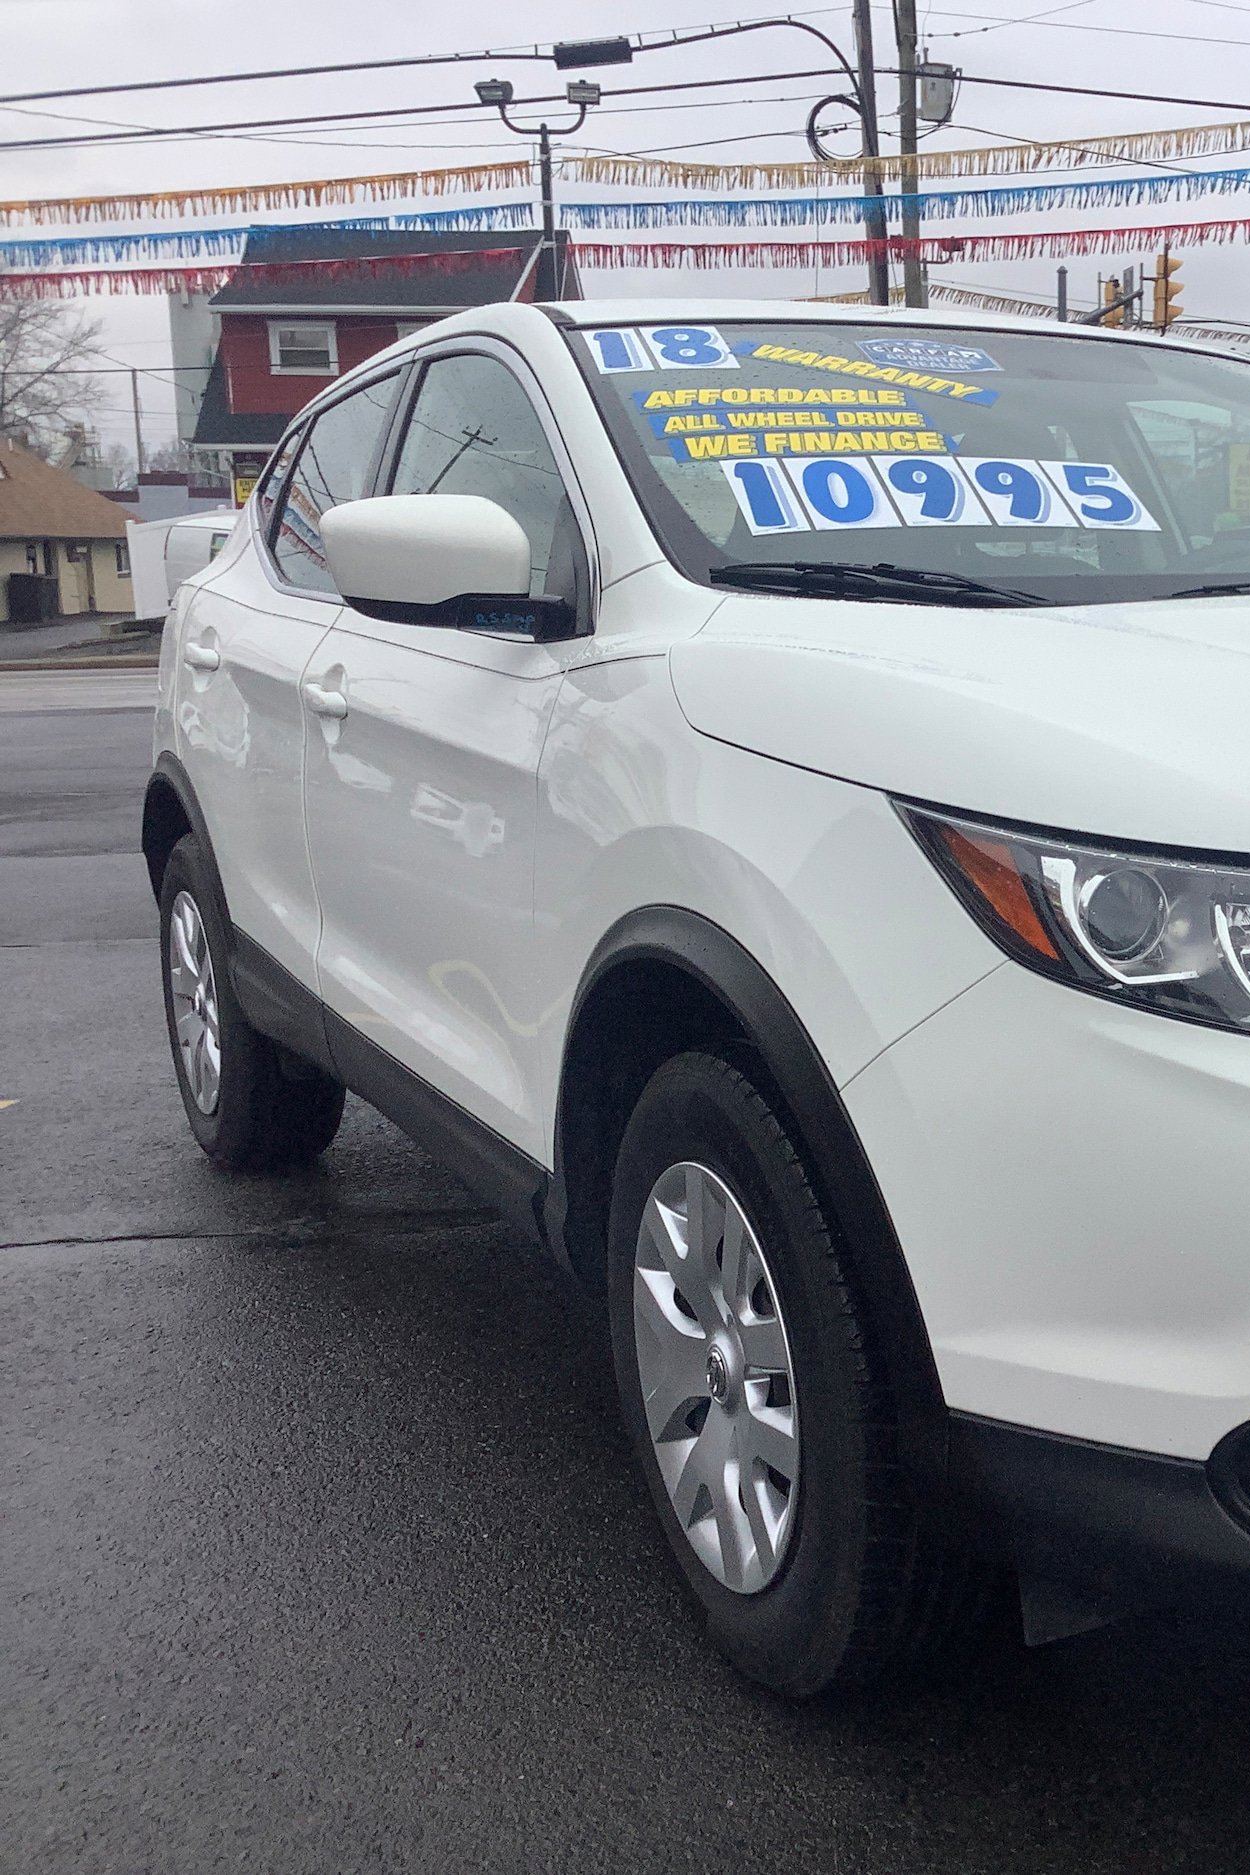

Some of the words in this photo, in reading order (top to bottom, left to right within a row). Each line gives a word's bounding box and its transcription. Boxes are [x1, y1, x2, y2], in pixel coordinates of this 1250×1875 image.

[593, 327, 730, 369] 18
[886, 353, 980, 366] ADVANTAGE
[752, 343, 983, 398] WARRANTY
[908, 360, 970, 370] DEALER
[643, 388, 907, 408] AFFORDABLE
[664, 413, 725, 433] ALL
[727, 411, 835, 430] WHEEL
[836, 410, 926, 428] DRIVE
[685, 433, 758, 461] WE
[764, 431, 948, 455] FINANCE
[733, 458, 1142, 529] 10995
